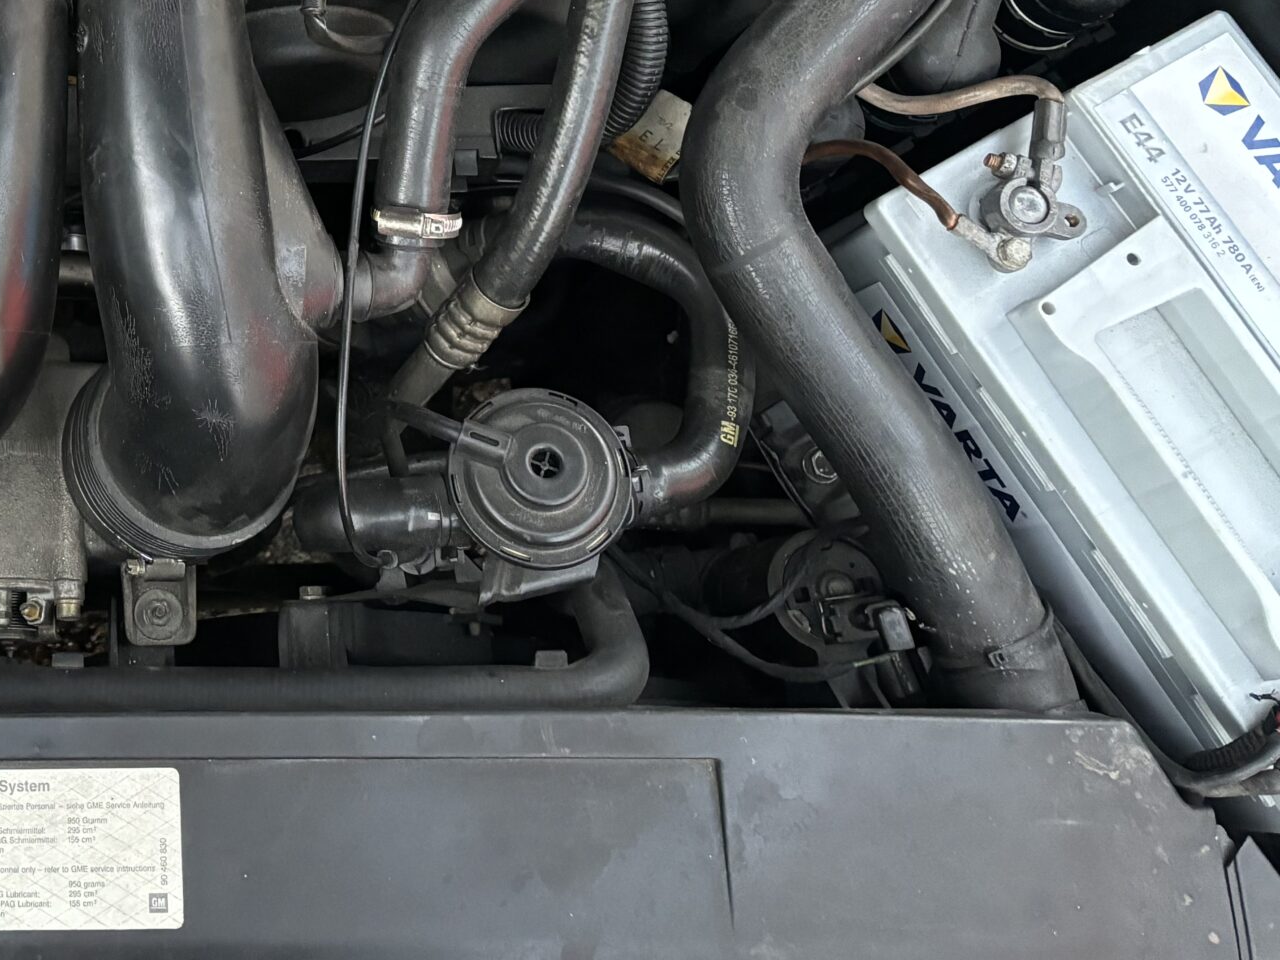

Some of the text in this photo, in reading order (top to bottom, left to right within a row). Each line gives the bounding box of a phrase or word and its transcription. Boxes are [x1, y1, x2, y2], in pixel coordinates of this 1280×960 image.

[1119, 112, 1166, 164] E44
[1171, 168, 1196, 195] 12V
[1160, 175, 1226, 258] 577 400 078 316 2
[720, 421, 739, 447] GM
[913, 362, 1021, 523] VARTA
[0, 780, 50, 795] System
[26, 802, 55, 810] Personal
[87, 802, 103, 810] GME
[106, 802, 131, 810] Service
[133, 802, 165, 810] Anleitung
[67, 826, 80, 834] 295
[21, 867, 36, 875] only
[83, 880, 105, 888] grams
[160, 874, 168, 885] 90
[6, 891, 40, 899] Lubricant:
[0, 900, 15, 908] PAG
[17, 900, 52, 908] Lubricant:
[152, 897, 166, 908] GM
